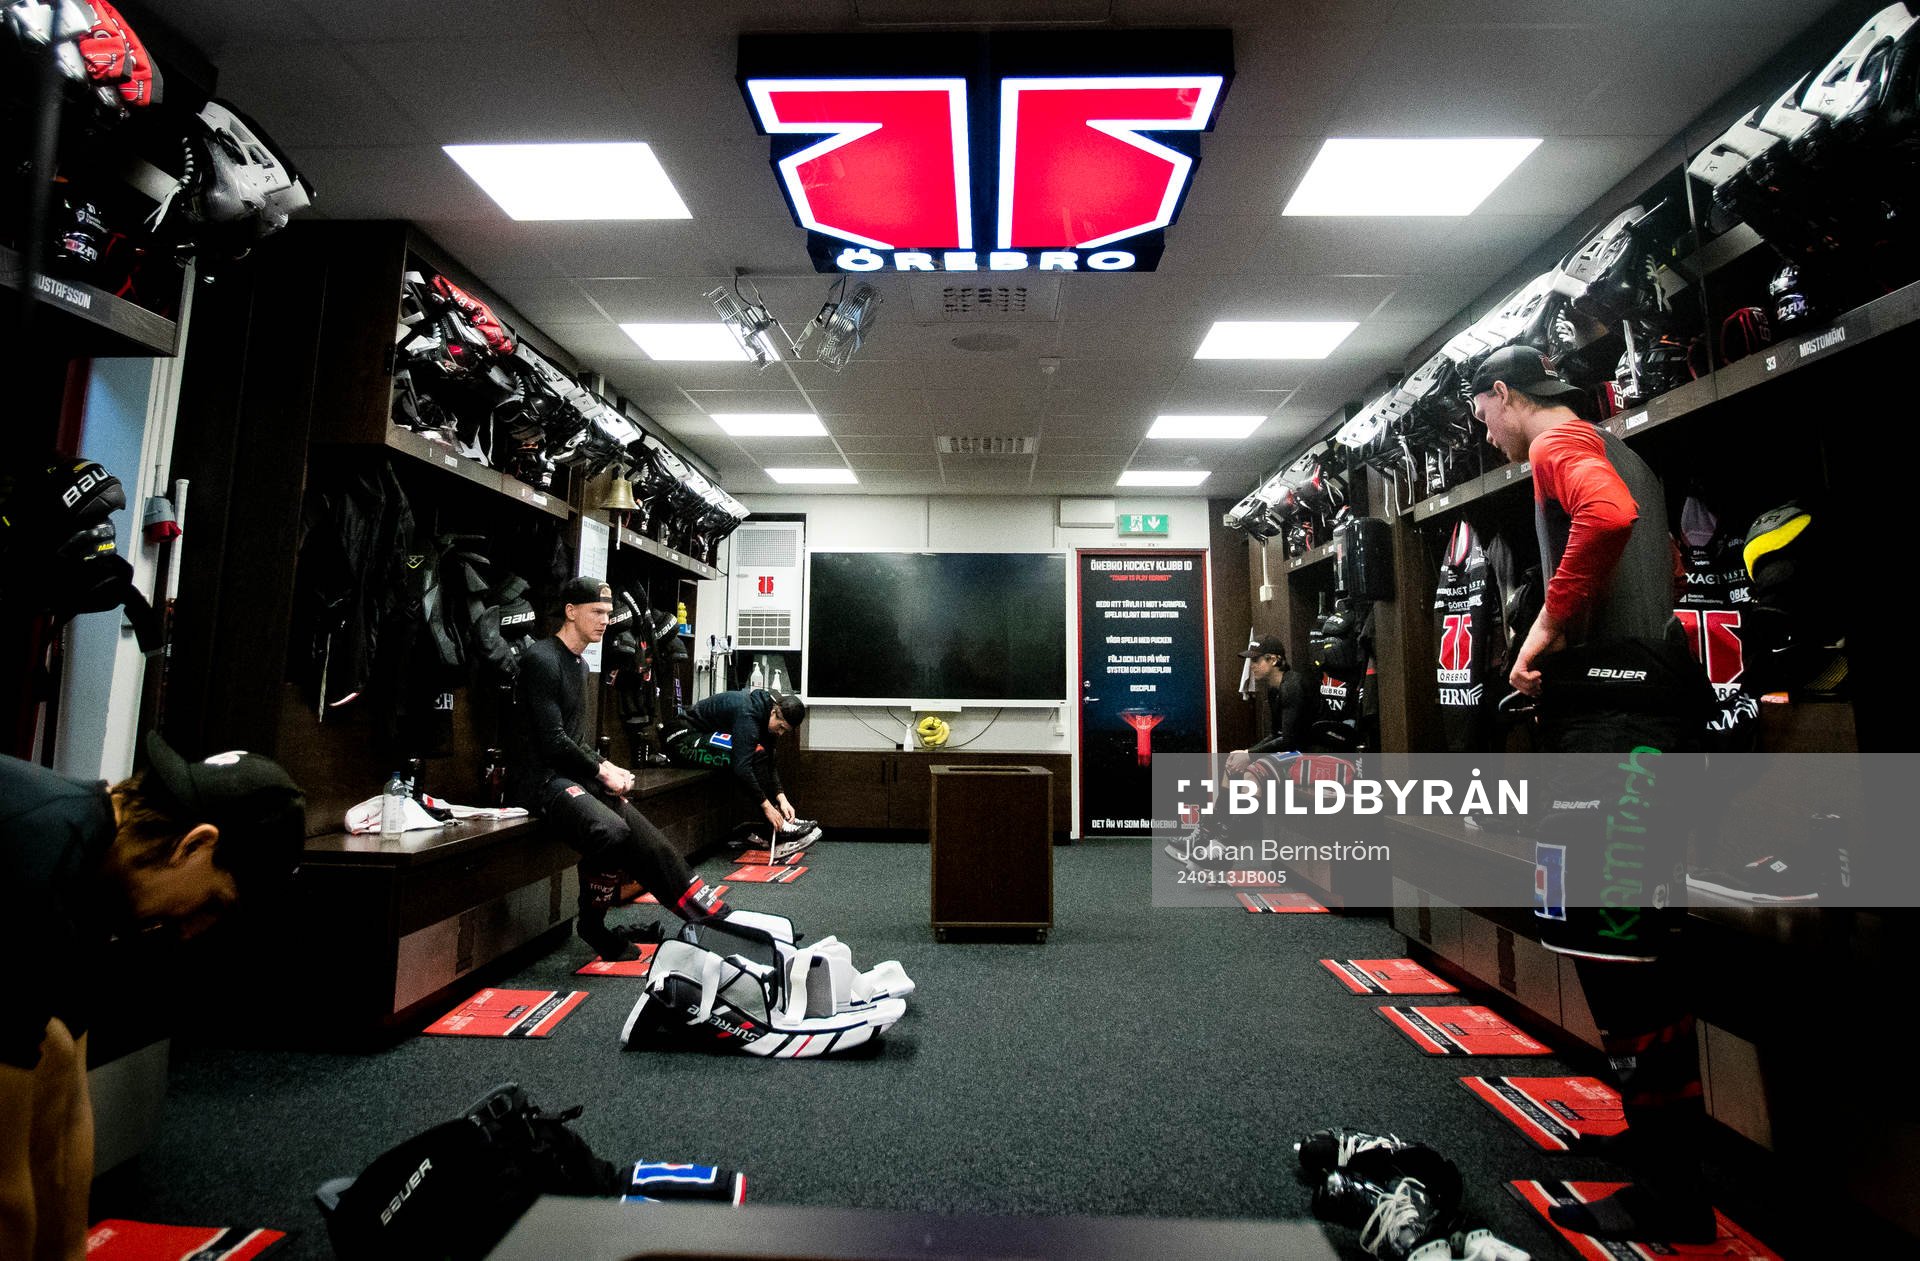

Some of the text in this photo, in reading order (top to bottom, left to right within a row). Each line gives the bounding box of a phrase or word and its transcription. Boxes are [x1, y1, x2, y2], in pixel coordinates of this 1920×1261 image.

[836, 248, 1136, 272] ÖREBRO
[1766, 326, 1846, 371] 33 MASTOMÄKI
[62, 467, 109, 508] BAU
[1090, 559, 1193, 571] ÖREBRO HOCKEY KLUBB ID
[1440, 672, 1468, 681] ÖREBRO
[1587, 668, 1647, 681] BAUER
[1092, 819, 1105, 829] DET
[1106, 818, 1116, 829] ÄR
[1116, 819, 1124, 829] VI
[1124, 819, 1140, 829] SOM
[1140, 818, 1150, 829] ÄR
[1150, 818, 1178, 829] ÖREBRO
[686, 1004, 760, 1042] SUPREE
[380, 1157, 433, 1227] BAUER
